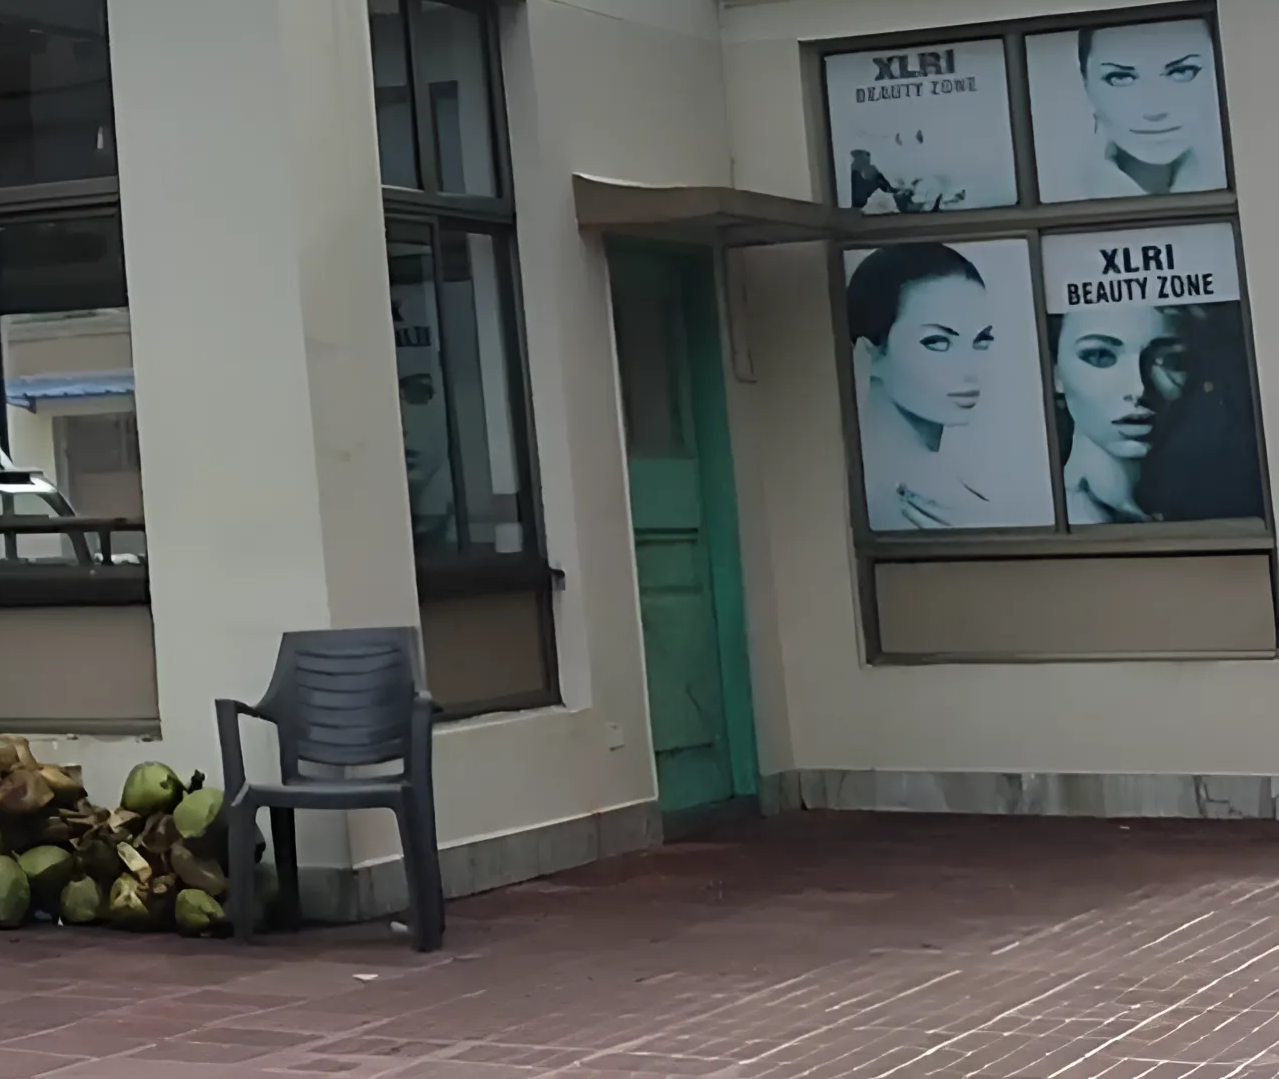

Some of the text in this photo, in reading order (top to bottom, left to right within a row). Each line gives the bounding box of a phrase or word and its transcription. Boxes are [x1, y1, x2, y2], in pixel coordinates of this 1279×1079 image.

[872, 48, 956, 82] XLRI
[855, 76, 979, 104] BEAUTY ZONE
[1098, 243, 1176, 275] XLRI
[1066, 273, 1215, 306] BEAUTY ZONE
